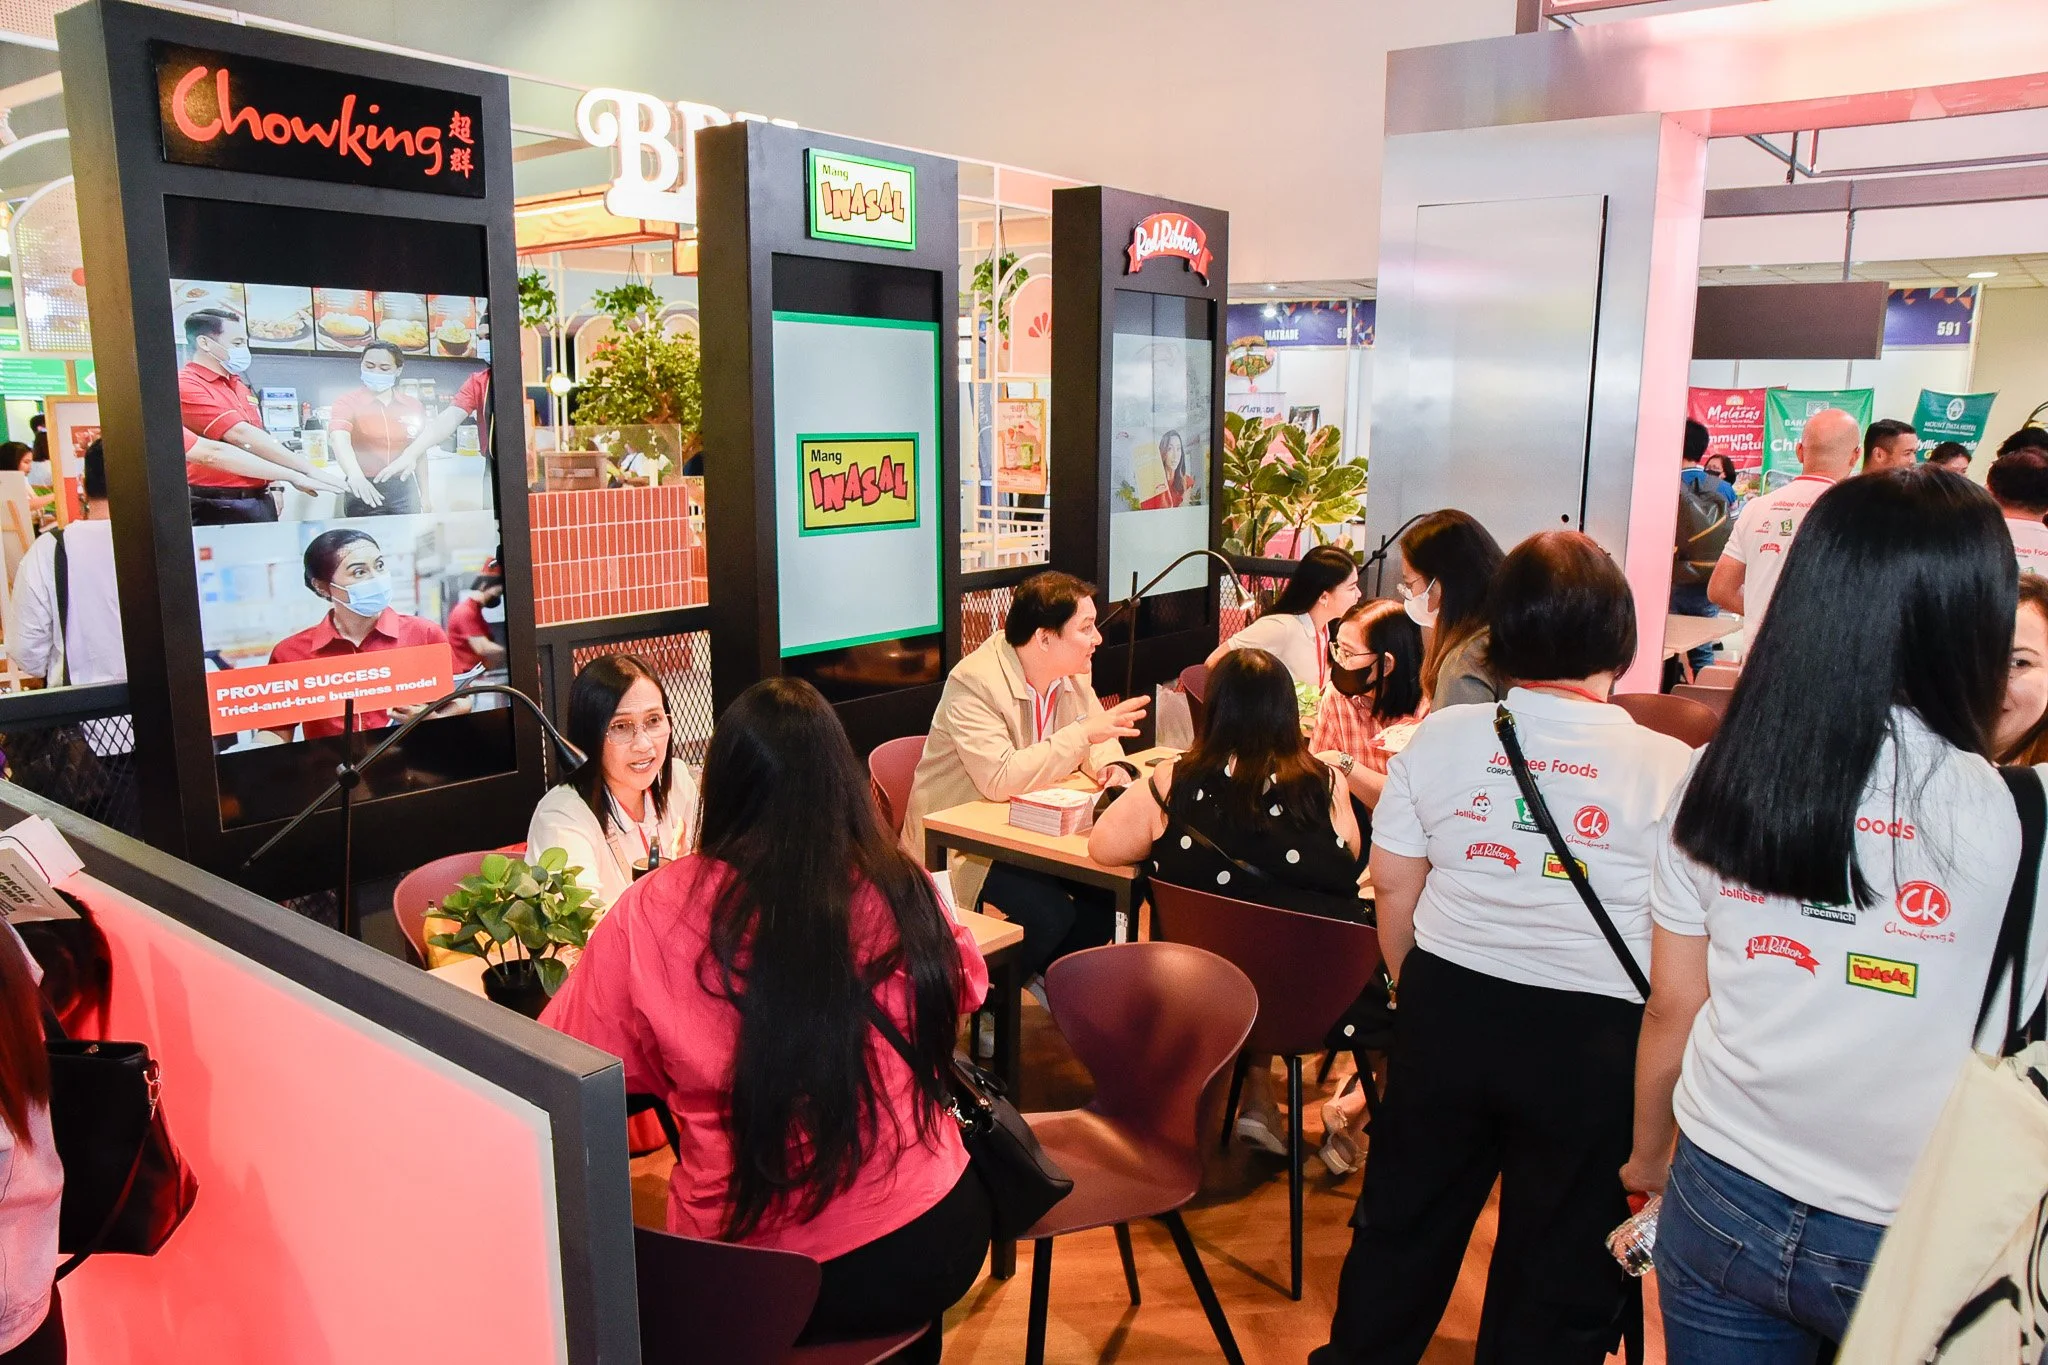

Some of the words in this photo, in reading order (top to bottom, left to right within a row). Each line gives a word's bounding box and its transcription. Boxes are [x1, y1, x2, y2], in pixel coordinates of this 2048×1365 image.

[172, 66, 443, 176] Chowking
[448, 110, 475, 179] 超群
[822, 164, 849, 181] Mang
[820, 181, 905, 223] INASAL
[1134, 221, 1160, 261] Red
[1160, 218, 1200, 256] Ribbon
[1264, 329, 1299, 341] MATRADE
[1936, 321, 1961, 336] 591
[1707, 405, 1760, 420] Malasag
[1708, 433, 1753, 443] mmune
[811, 449, 842, 465] Mang
[809, 455, 908, 513] INASAL
[216, 679, 299, 701] PROVEN
[304, 666, 391, 689] SUCCESS
[217, 694, 326, 717] Tried-and-true
[329, 685, 392, 701] business
[395, 677, 437, 692] model
[1489, 752, 1546, 771] Joee
[1552, 758, 1598, 778] Foods
[1453, 809, 1487, 822] Jollibee
[1576, 811, 1603, 837] Ck
[1855, 816, 1915, 840] oods
[1470, 844, 1483, 856] Red
[1484, 843, 1512, 860] Ribbon
[1719, 886, 1766, 904] Jollibee
[1901, 888, 1942, 924] Ck
[1802, 904, 1856, 923] greenwich
[1751, 936, 1767, 954] Red
[1767, 935, 1806, 960] Ribbon
[1853, 964, 1910, 986] INASAL
